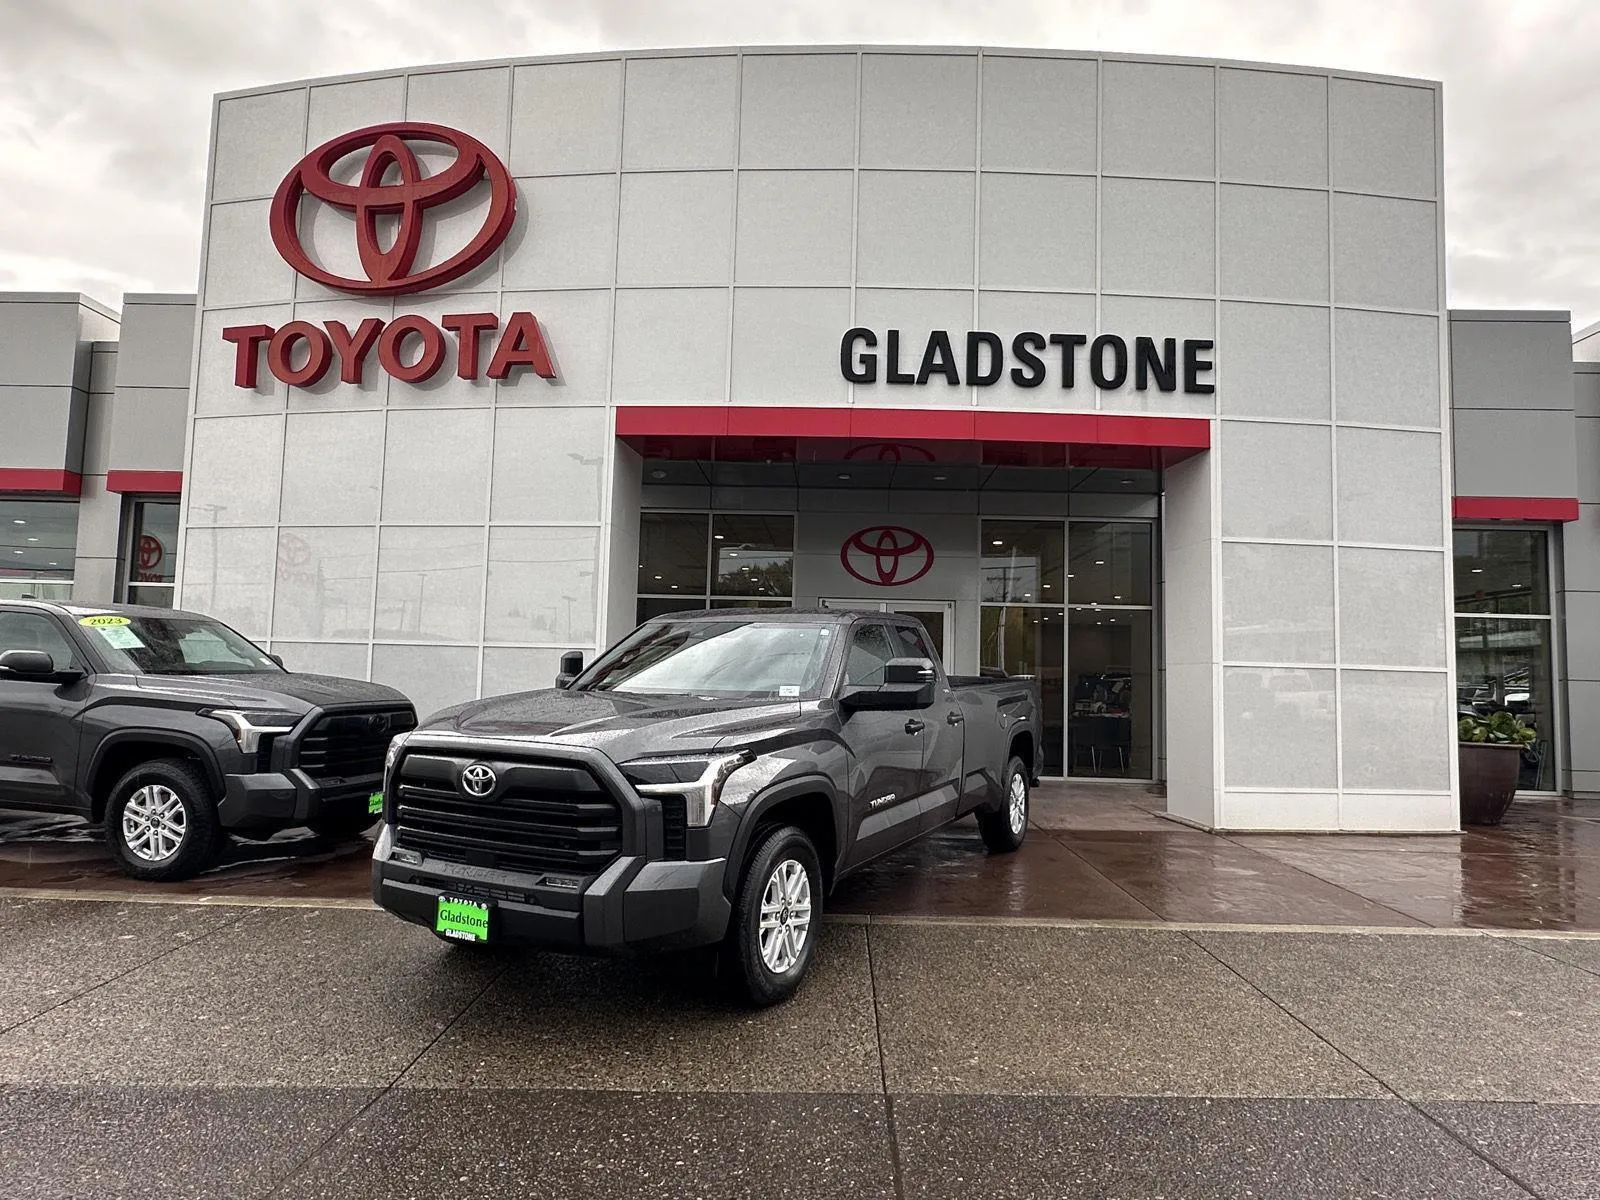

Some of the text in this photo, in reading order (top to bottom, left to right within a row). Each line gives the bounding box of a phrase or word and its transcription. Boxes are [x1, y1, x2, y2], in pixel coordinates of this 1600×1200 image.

[222, 311, 557, 388] TOYOTA
[840, 327, 1215, 394] GLADSTONE
[89, 617, 122, 625] 2023
[449, 897, 478, 907] TOYOTA
[440, 910, 489, 928] Gladstone
[446, 929, 476, 941] GLADSTONE
